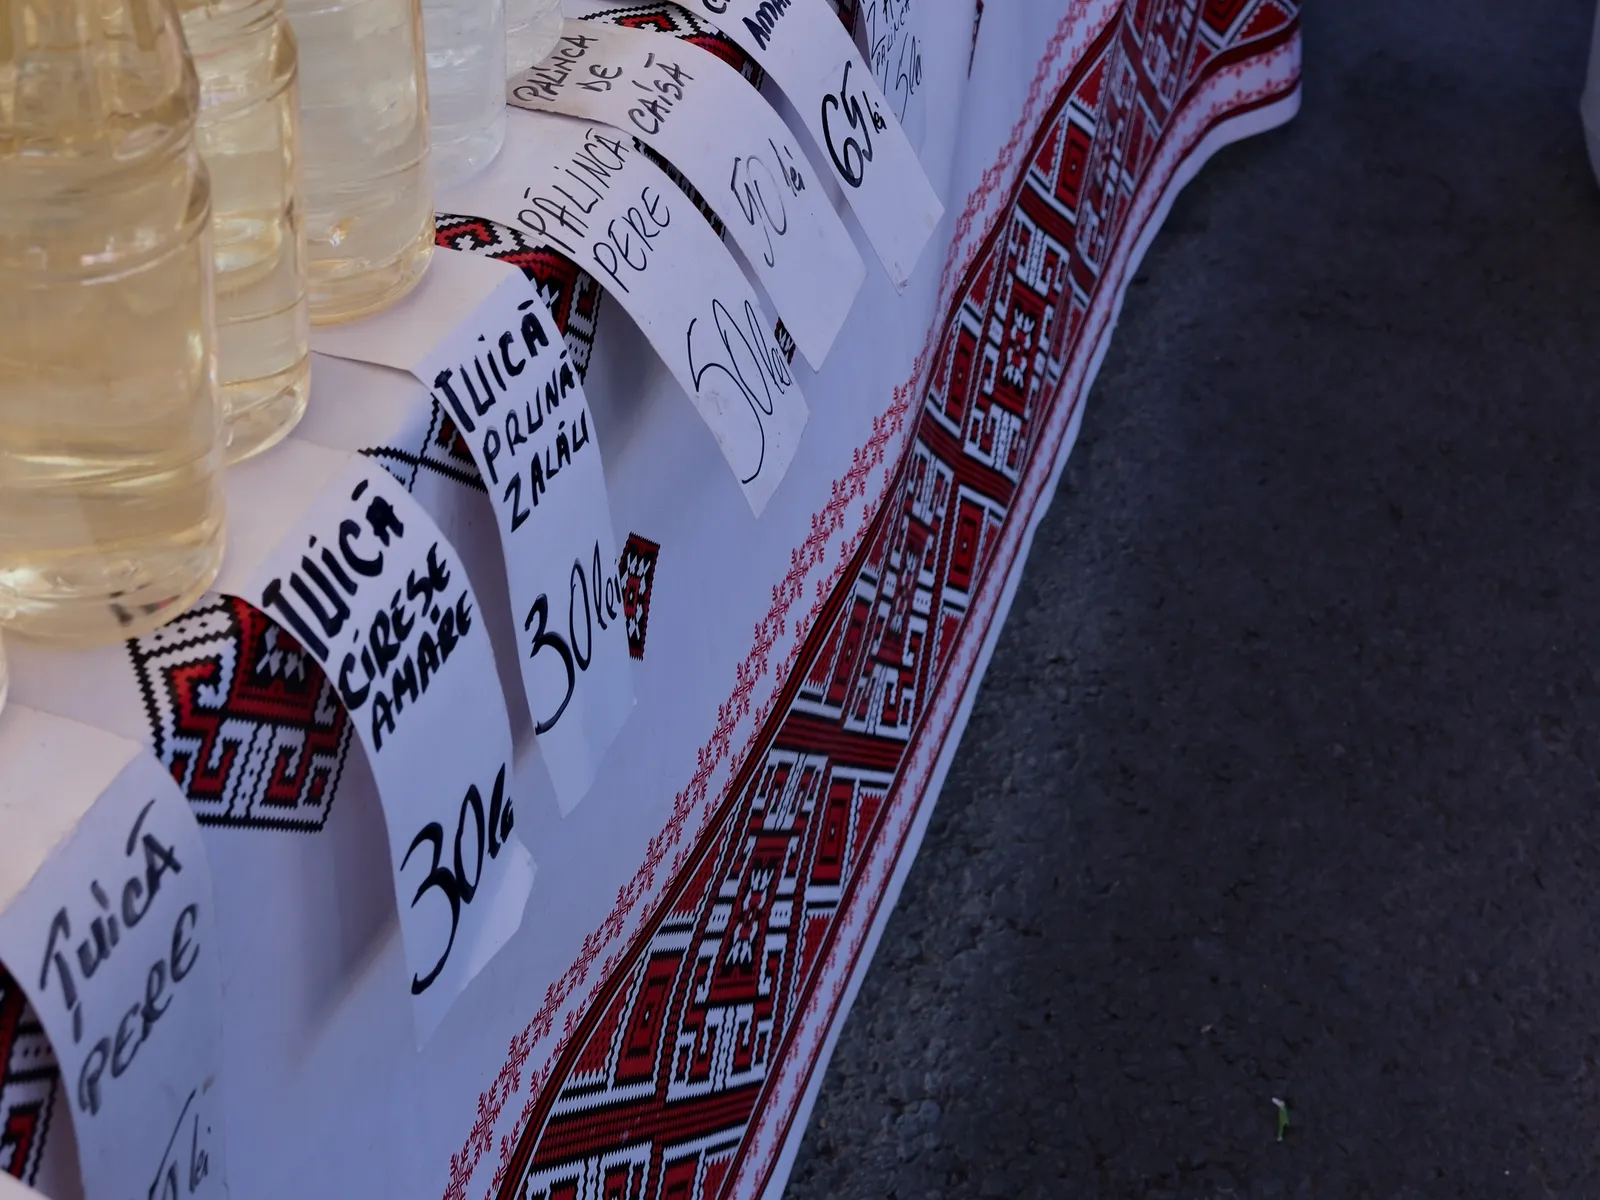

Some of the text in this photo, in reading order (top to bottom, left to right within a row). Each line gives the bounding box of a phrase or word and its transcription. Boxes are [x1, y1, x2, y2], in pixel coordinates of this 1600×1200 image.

[576, 64, 622, 93] DE
[593, 187, 671, 293] PERE
[78, 902, 200, 1117] PERE
